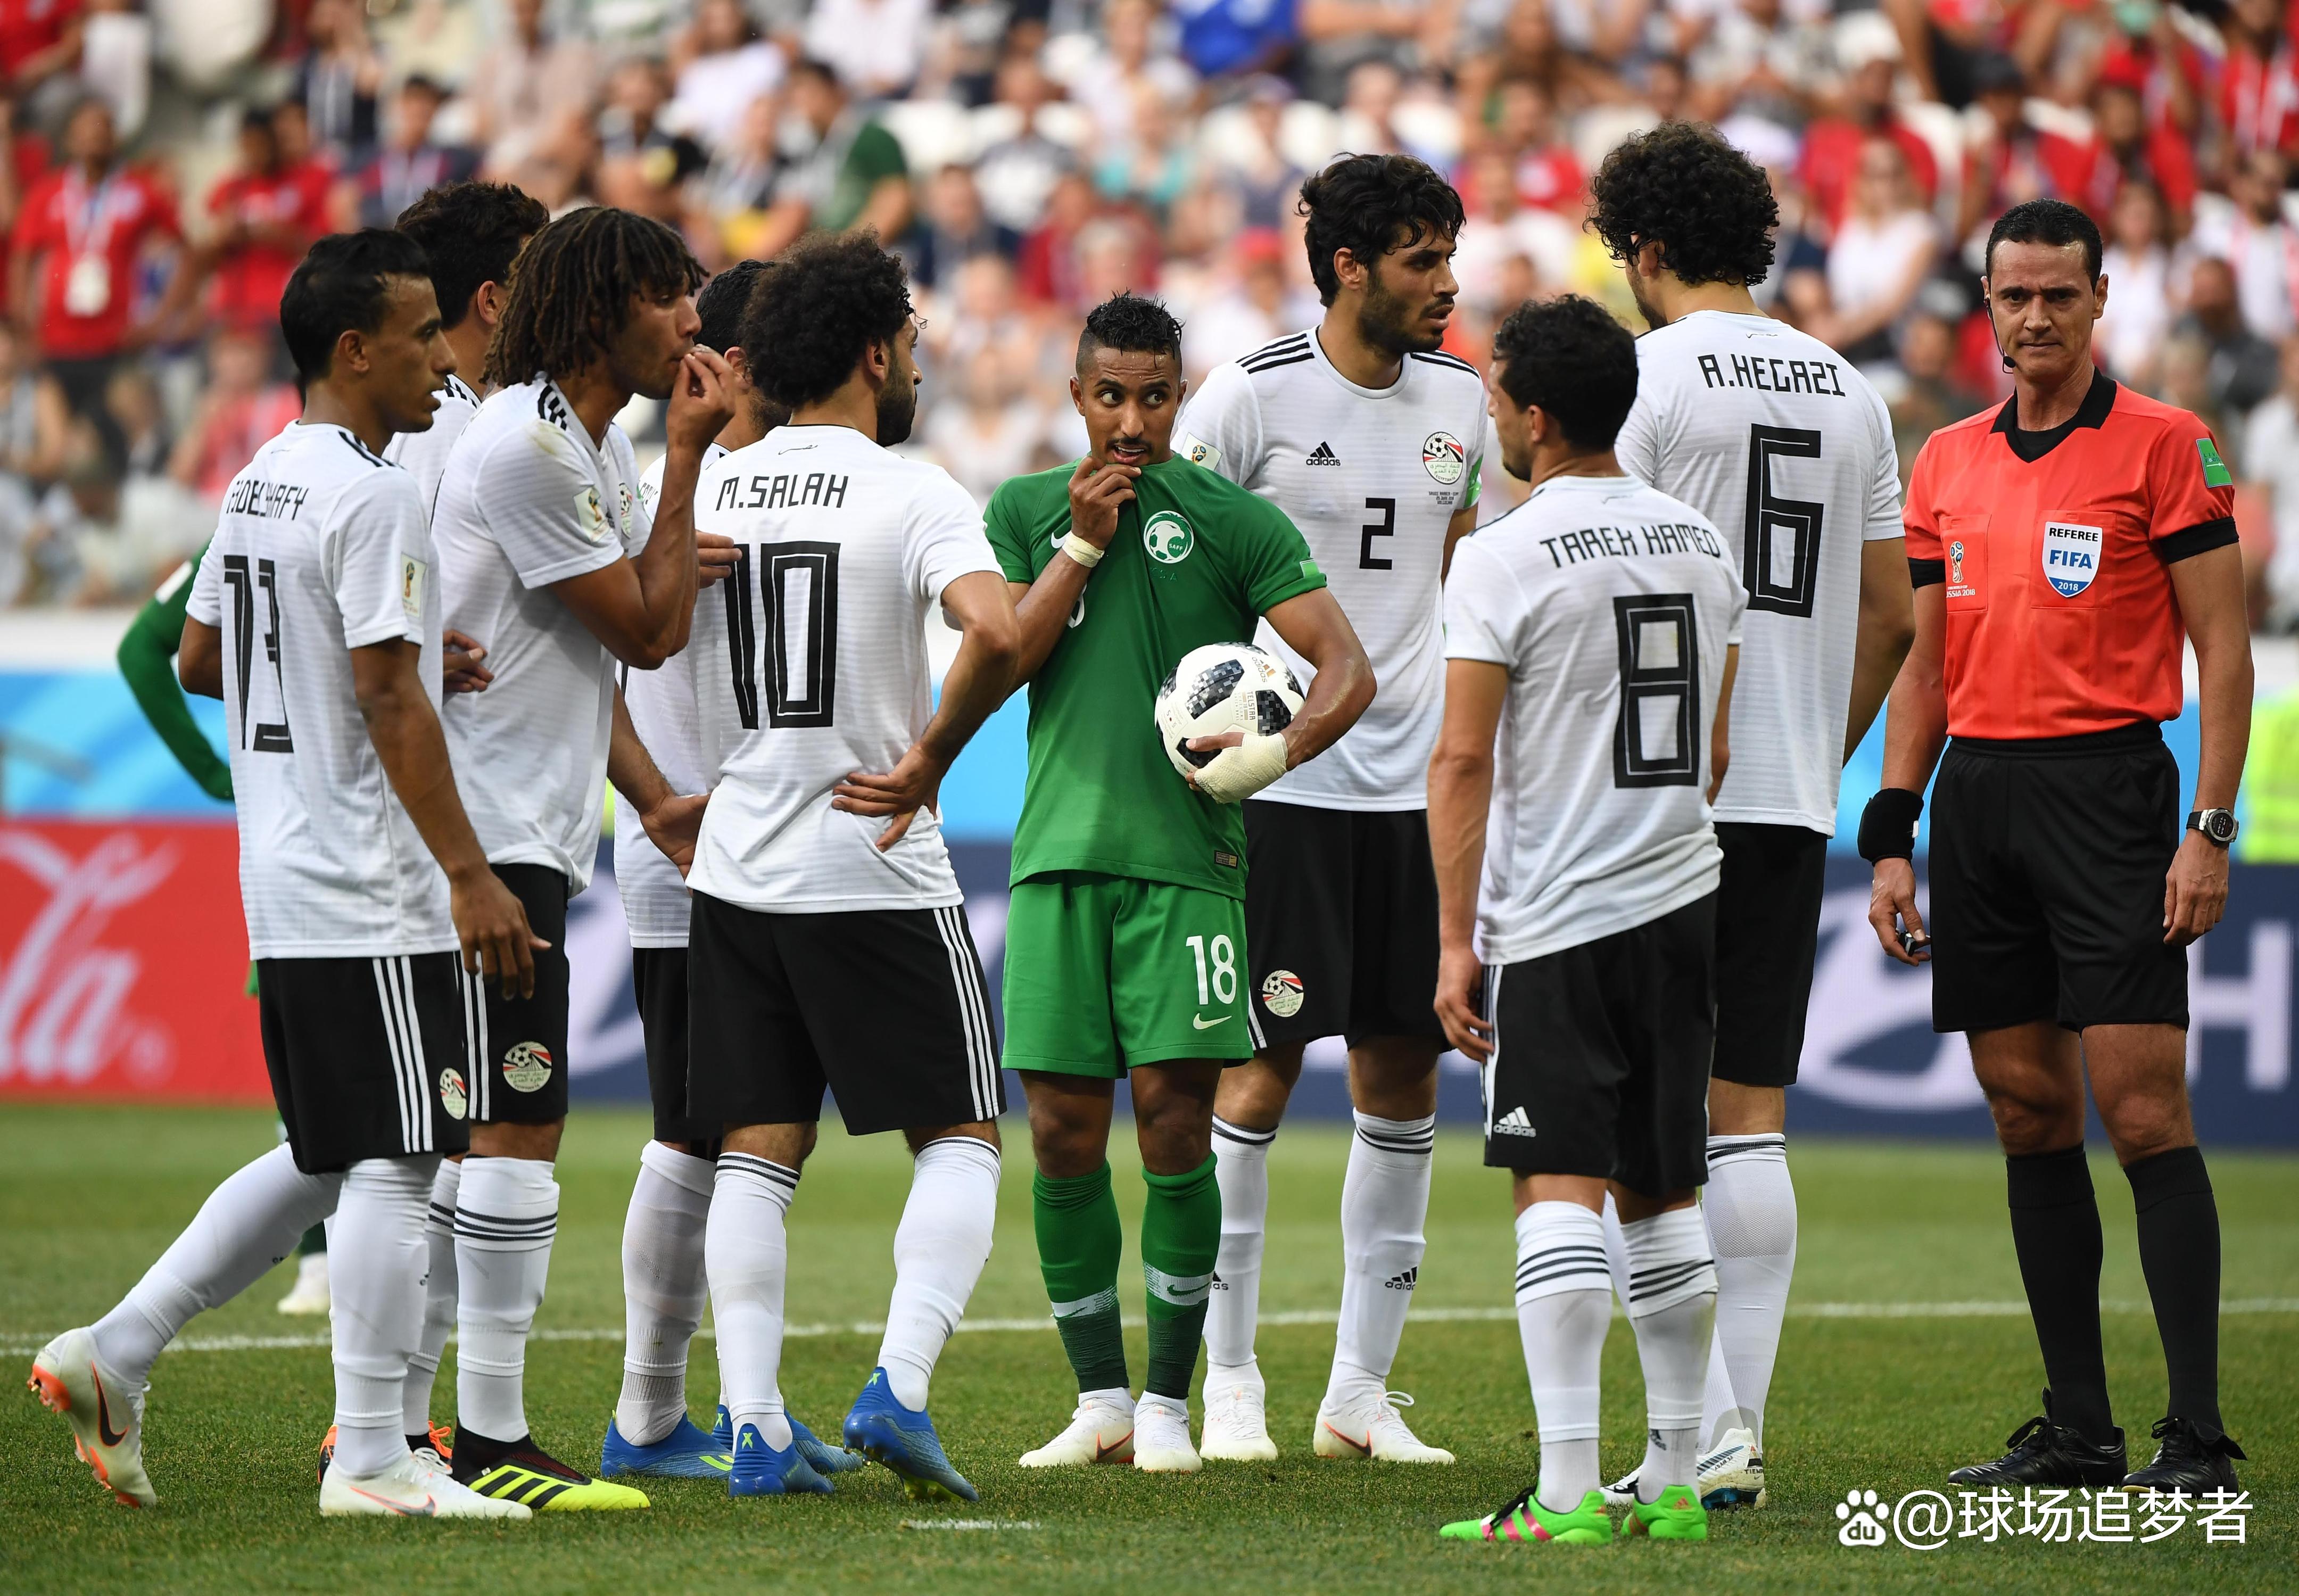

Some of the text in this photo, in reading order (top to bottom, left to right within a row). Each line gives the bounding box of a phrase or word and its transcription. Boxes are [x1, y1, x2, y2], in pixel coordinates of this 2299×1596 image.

[1697, 353, 1846, 397] A.HEGAZI
[1305, 457, 1341, 466] adidas
[716, 473, 849, 511] M.SALAH
[1359, 498, 1395, 570] 2
[1743, 423, 1824, 618] 6
[2049, 527, 2099, 542] REFEREE
[1540, 524, 1721, 568] TAREK HAMED
[2049, 549, 2093, 569] FIFA
[2058, 581, 2079, 591] 2018
[224, 555, 294, 754] 13
[724, 541, 841, 730] 10
[1252, 657, 1267, 682] adidas
[1247, 691, 1255, 720] TELSTAR
[1614, 593, 1700, 788] 8
[1186, 935, 1236, 1005] 18
[1493, 1123, 1536, 1137] adidas
